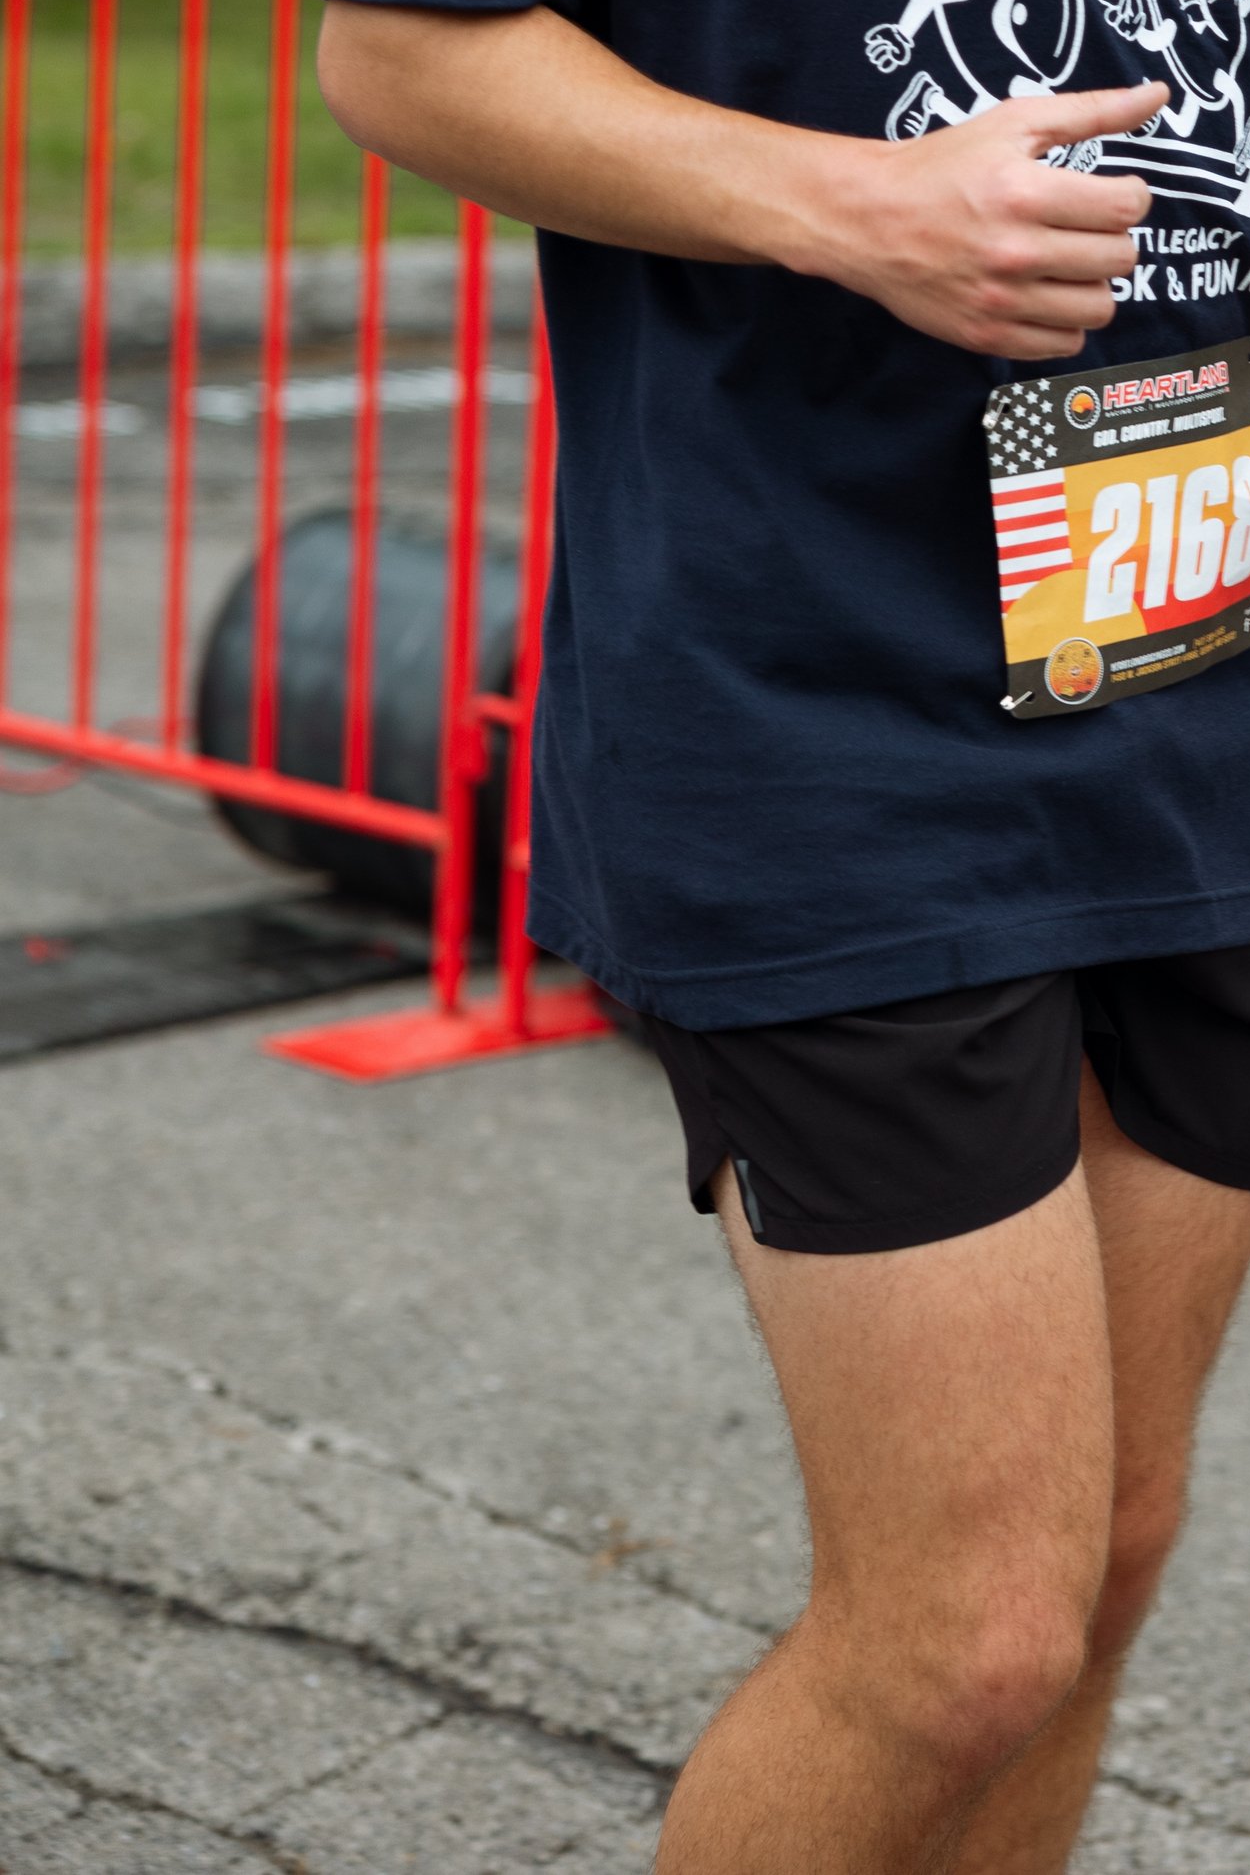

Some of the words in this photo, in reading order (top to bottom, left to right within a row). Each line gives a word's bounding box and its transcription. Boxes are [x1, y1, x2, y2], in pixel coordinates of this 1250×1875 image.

[1157, 227, 1244, 255] LEGACY
[1166, 266, 1187, 301] &
[1191, 257, 1240, 301] FUN
[1103, 361, 1229, 410] HEARTLAND
